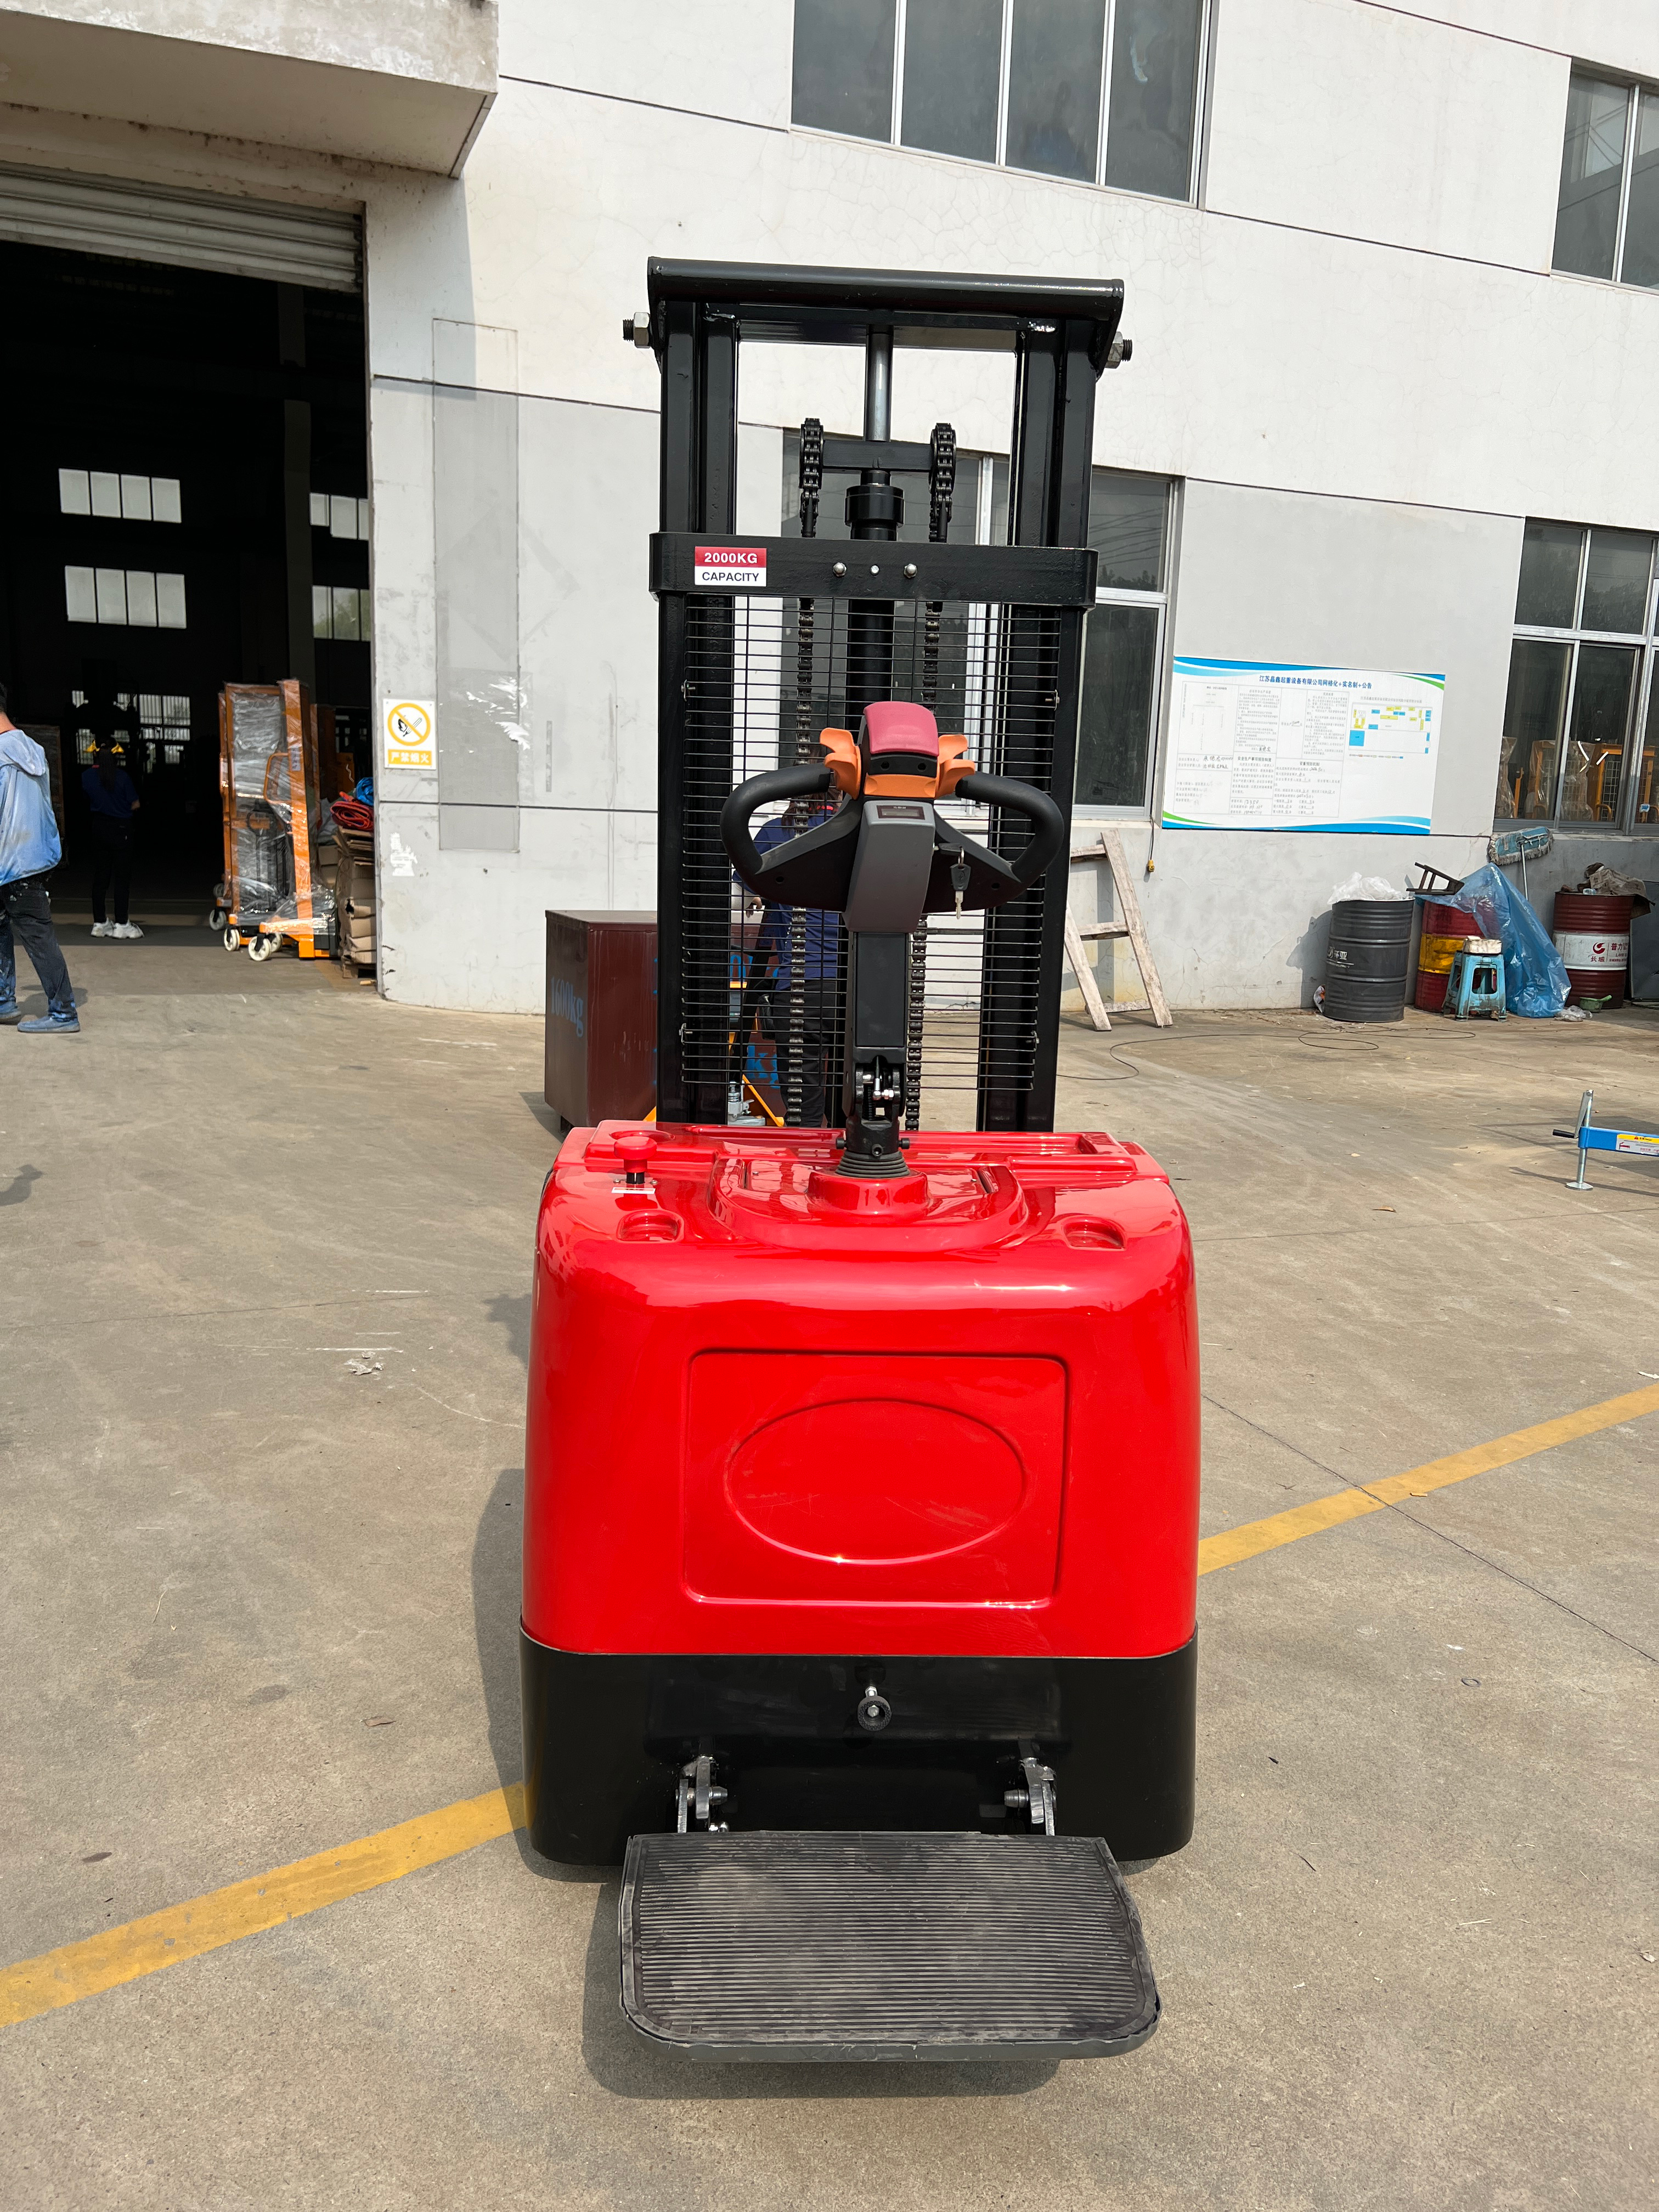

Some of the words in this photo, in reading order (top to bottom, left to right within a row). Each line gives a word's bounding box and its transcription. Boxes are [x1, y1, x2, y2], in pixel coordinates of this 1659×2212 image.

[704, 552, 758, 563] 2000KG
[702, 572, 759, 582] CAPACITY
[391, 752, 430, 764] 严禁烟火
[551, 975, 584, 1038] 1600kg
